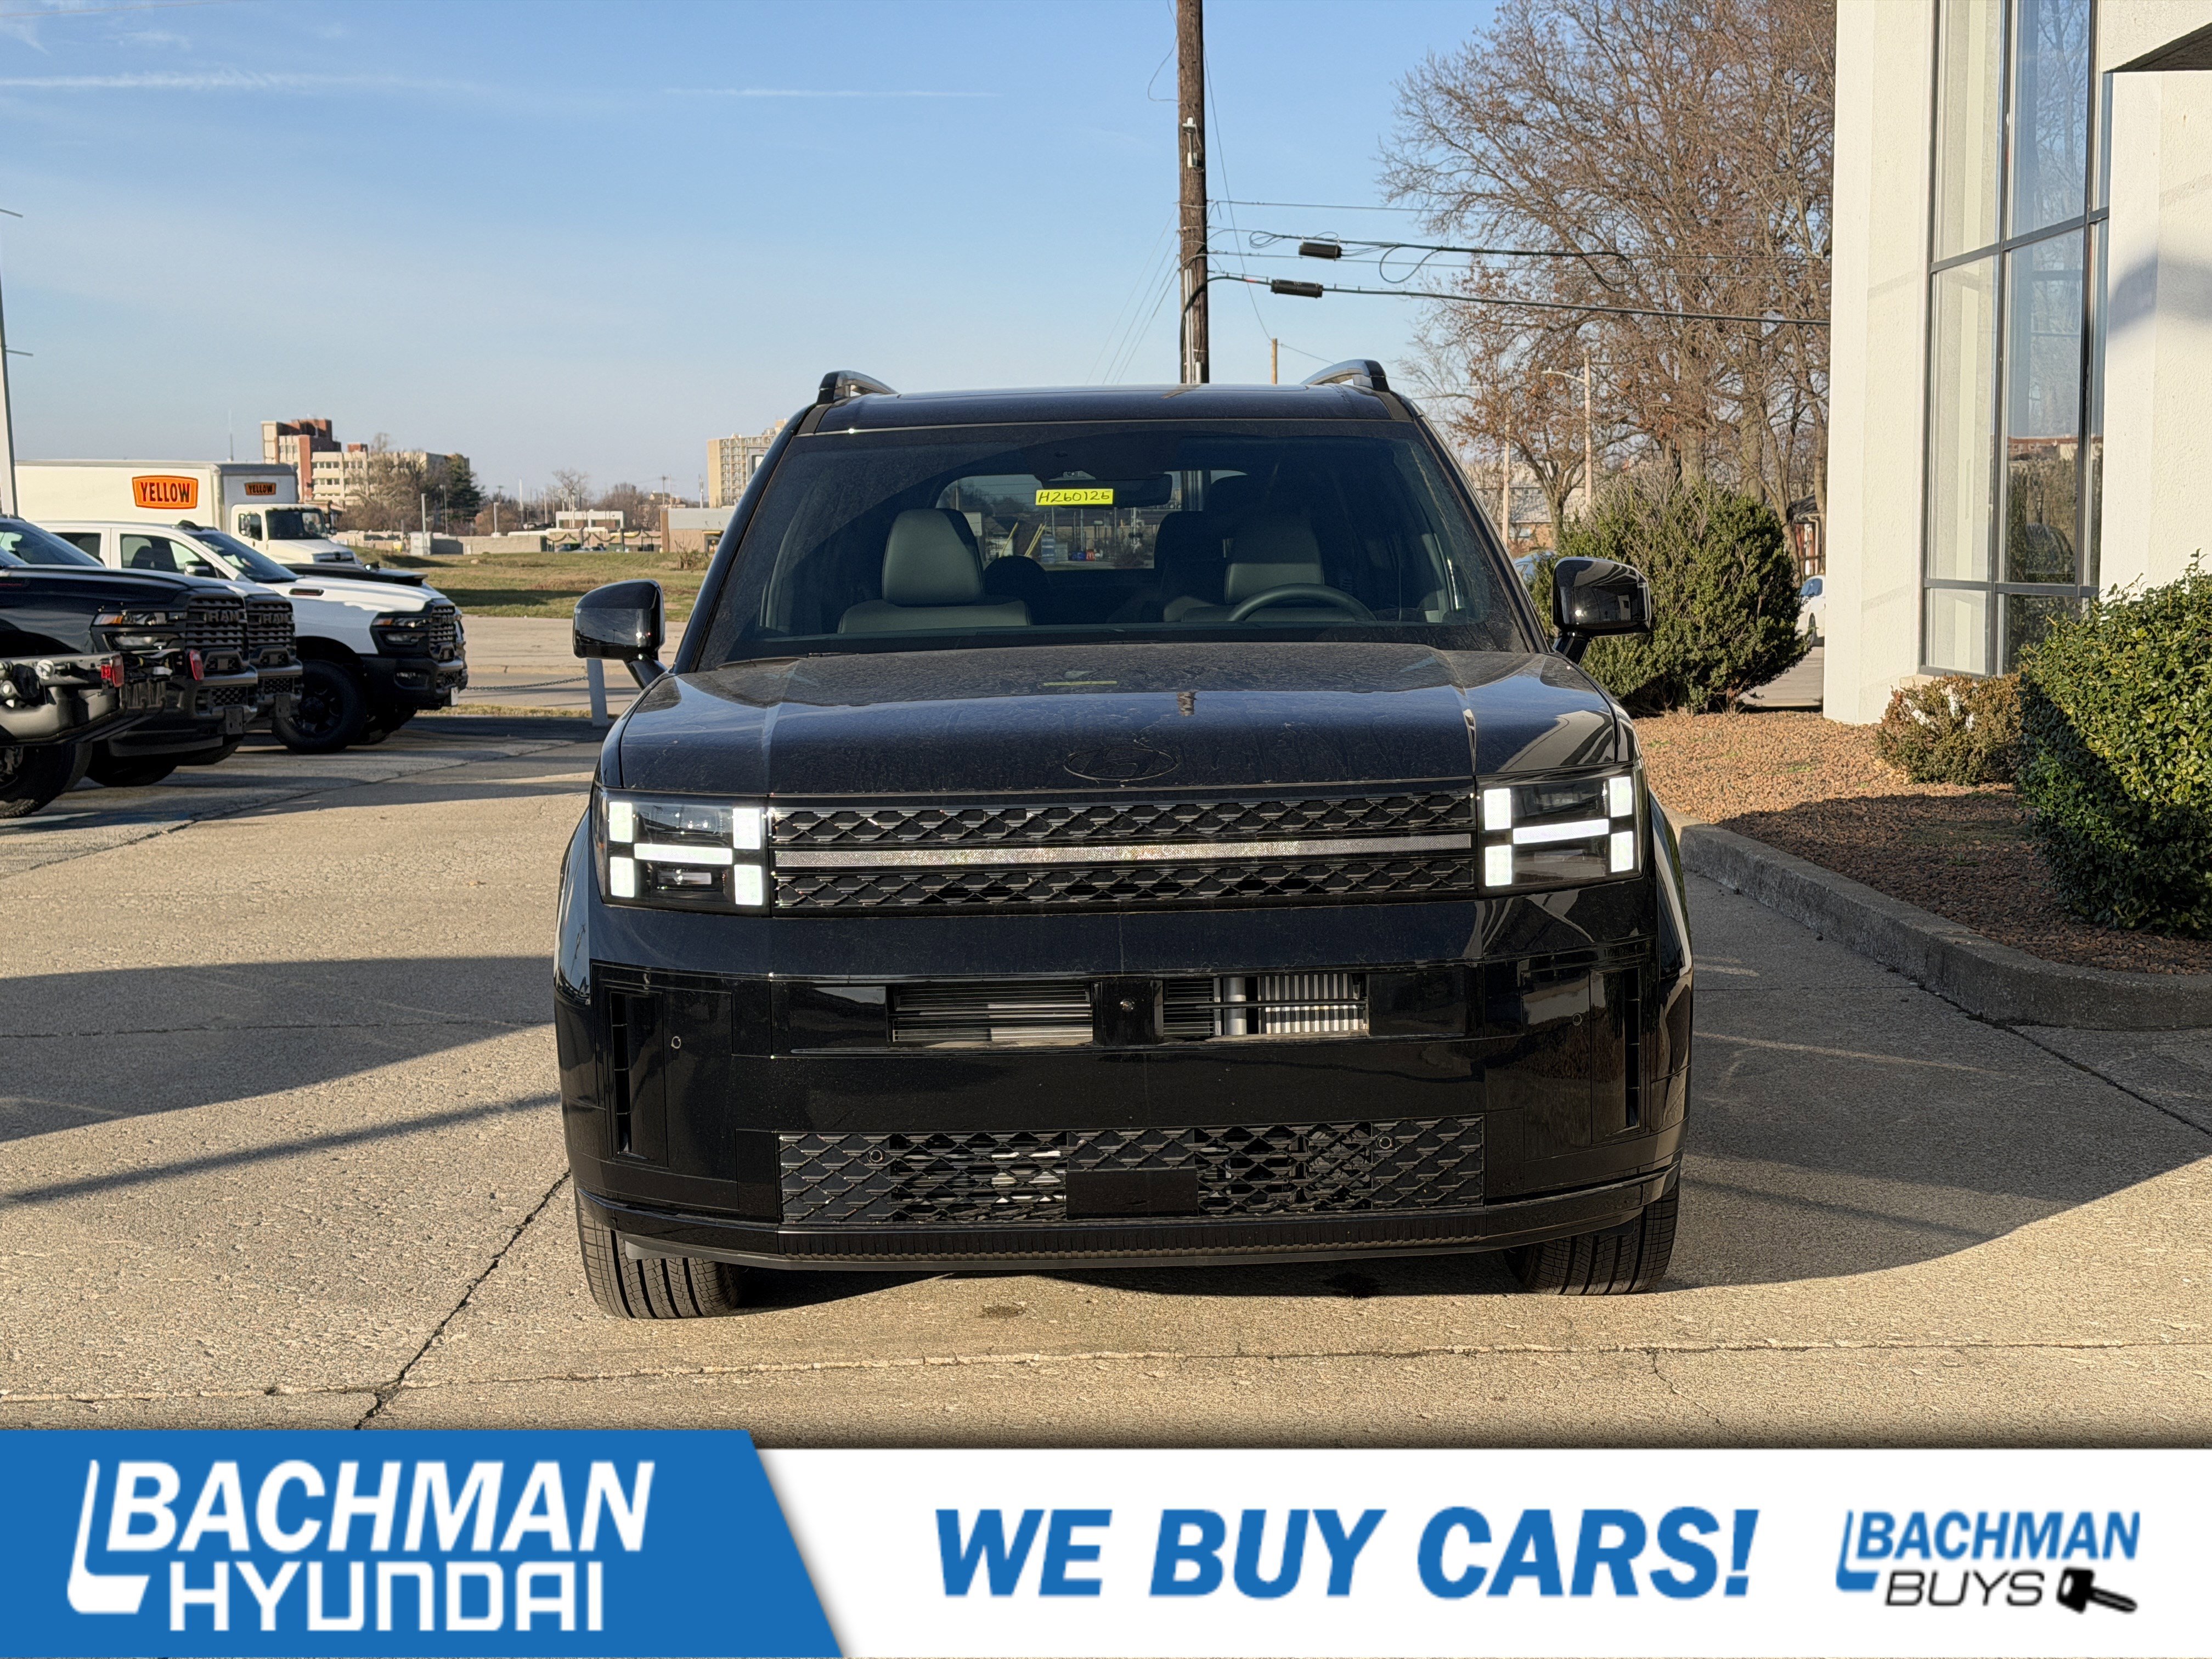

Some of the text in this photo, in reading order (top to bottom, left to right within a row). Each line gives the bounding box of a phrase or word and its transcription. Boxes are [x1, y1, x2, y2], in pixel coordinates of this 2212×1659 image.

[140, 482, 190, 503] YELLOW
[249, 484, 273, 494] YELLOW
[208, 610, 239, 622] RAM
